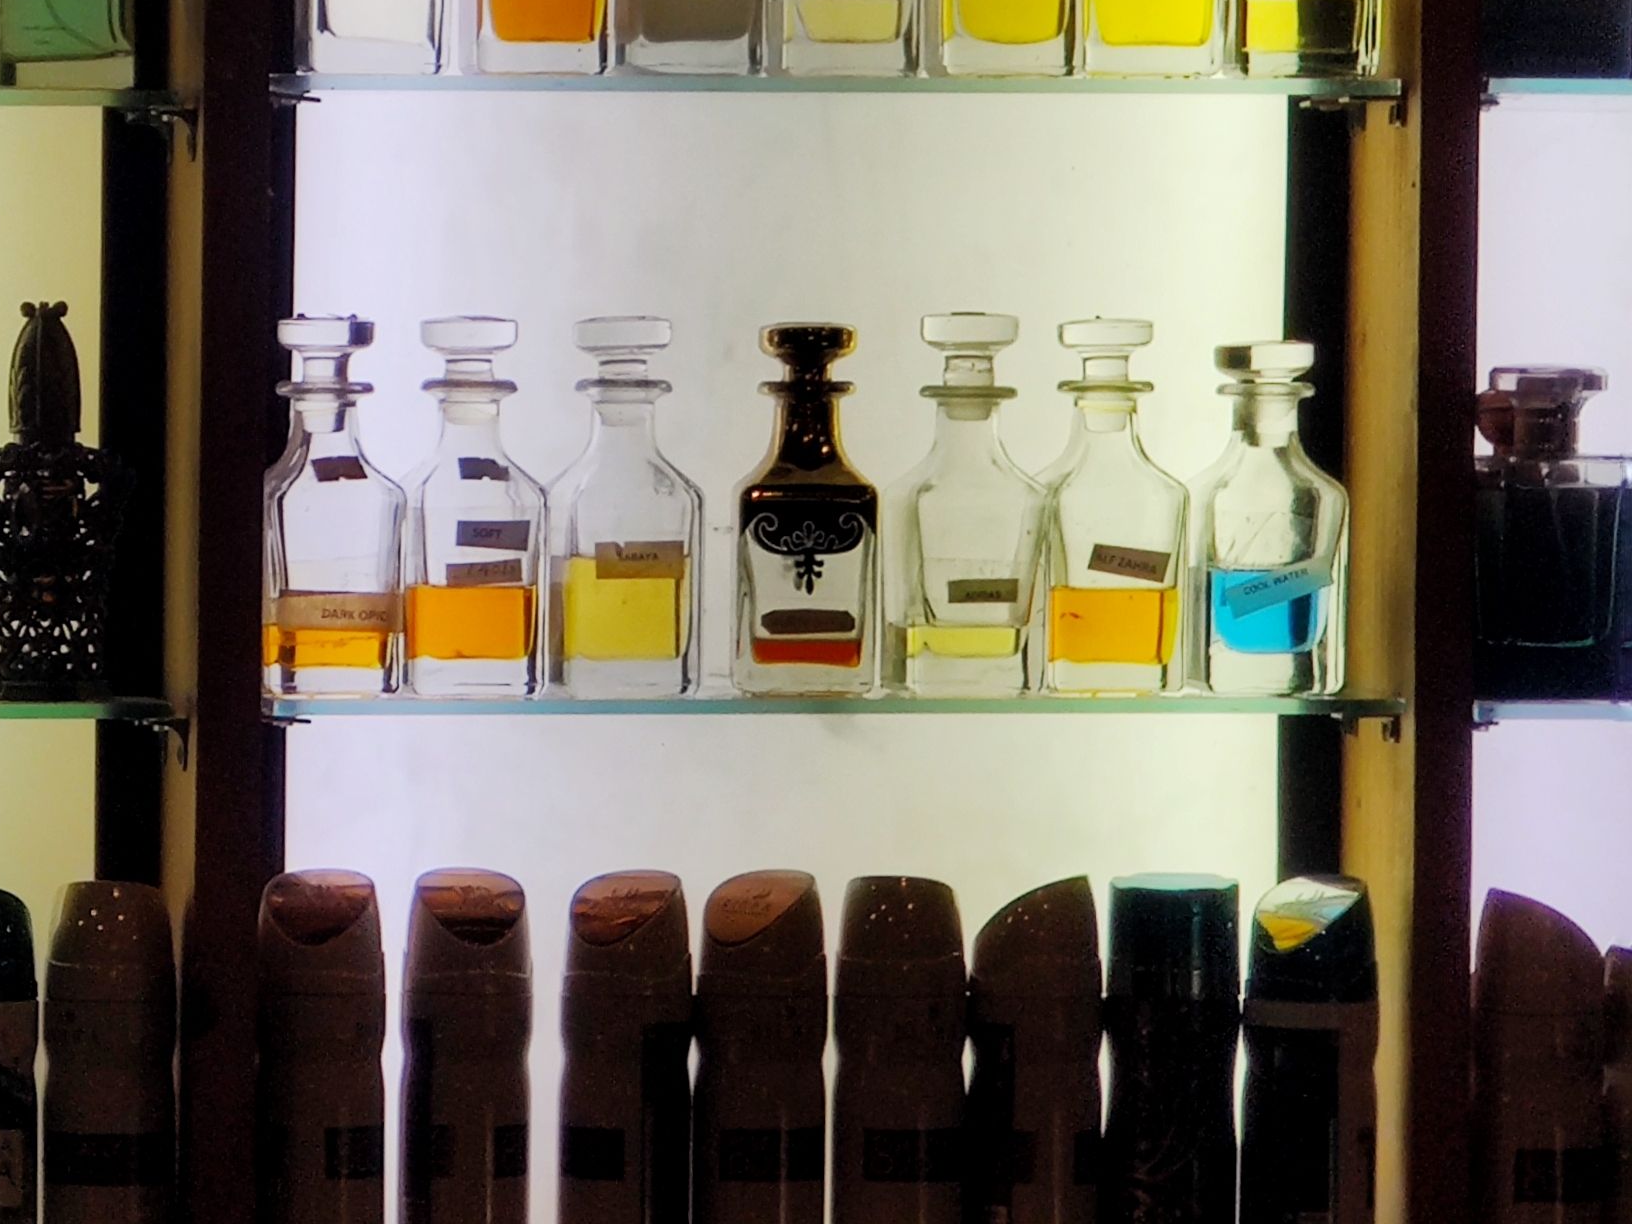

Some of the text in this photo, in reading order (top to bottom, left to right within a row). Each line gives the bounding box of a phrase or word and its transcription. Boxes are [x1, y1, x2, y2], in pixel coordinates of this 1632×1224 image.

[472, 527, 503, 540] SOFT
[1243, 568, 1310, 596] COOL WATER
[320, 608, 355, 620] DARK
